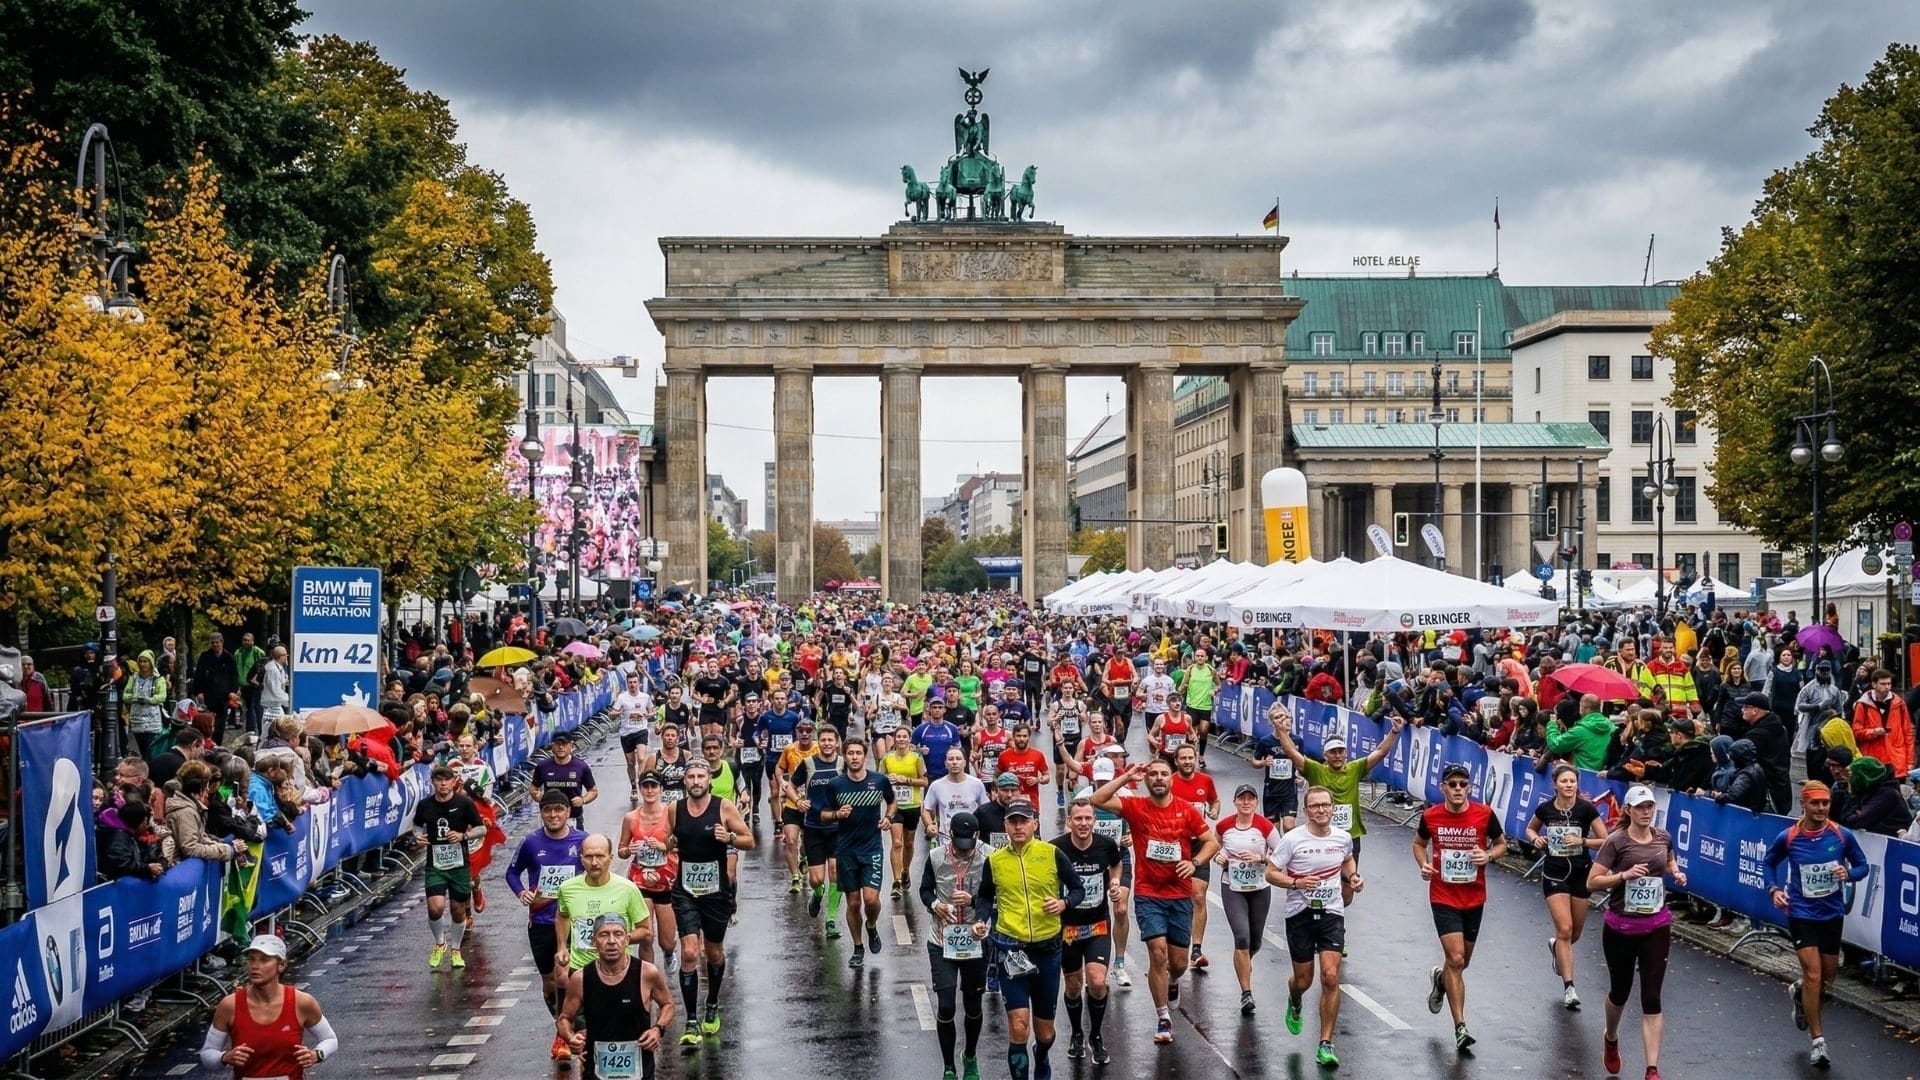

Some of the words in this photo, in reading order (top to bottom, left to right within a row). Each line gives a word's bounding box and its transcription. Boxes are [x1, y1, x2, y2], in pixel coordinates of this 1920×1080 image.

[1352, 256, 1385, 266] HOTEL
[303, 580, 346, 594] BMW
[303, 595, 345, 606] BERLIN
[302, 607, 371, 618] MARATHON
[299, 642, 338, 664] km
[344, 643, 373, 664] 42
[1437, 827, 1462, 836] BMW
[1630, 888, 1656, 900] 7631
[601, 1055, 631, 1068] 1426
